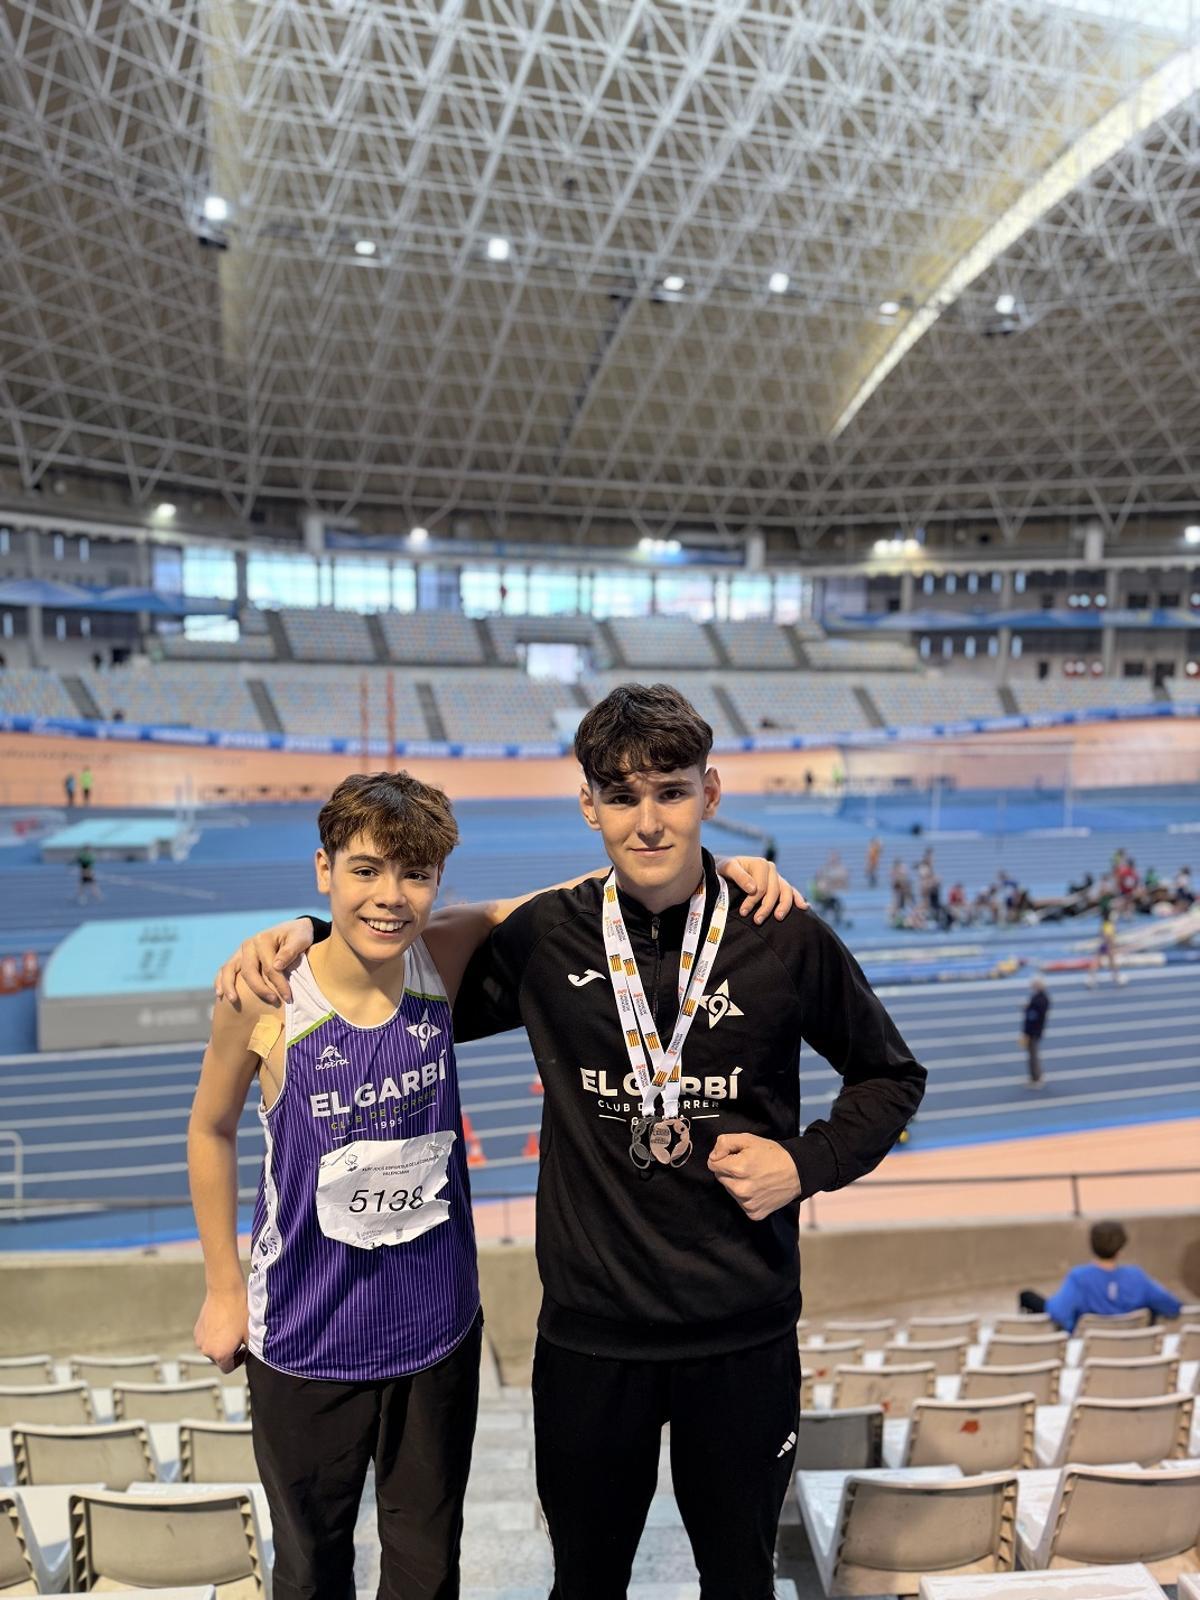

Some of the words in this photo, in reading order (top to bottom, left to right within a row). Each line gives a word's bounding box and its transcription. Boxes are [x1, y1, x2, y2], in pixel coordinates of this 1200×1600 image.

[310, 1091, 350, 1118] EL
[355, 1049, 446, 1108] GARBÍ
[579, 1067, 617, 1097] EL
[623, 1066, 743, 1099] GRBÍ
[597, 1099, 631, 1113] CLUB
[373, 1116, 403, 1130] 1995
[349, 1185, 424, 1213] 5138
